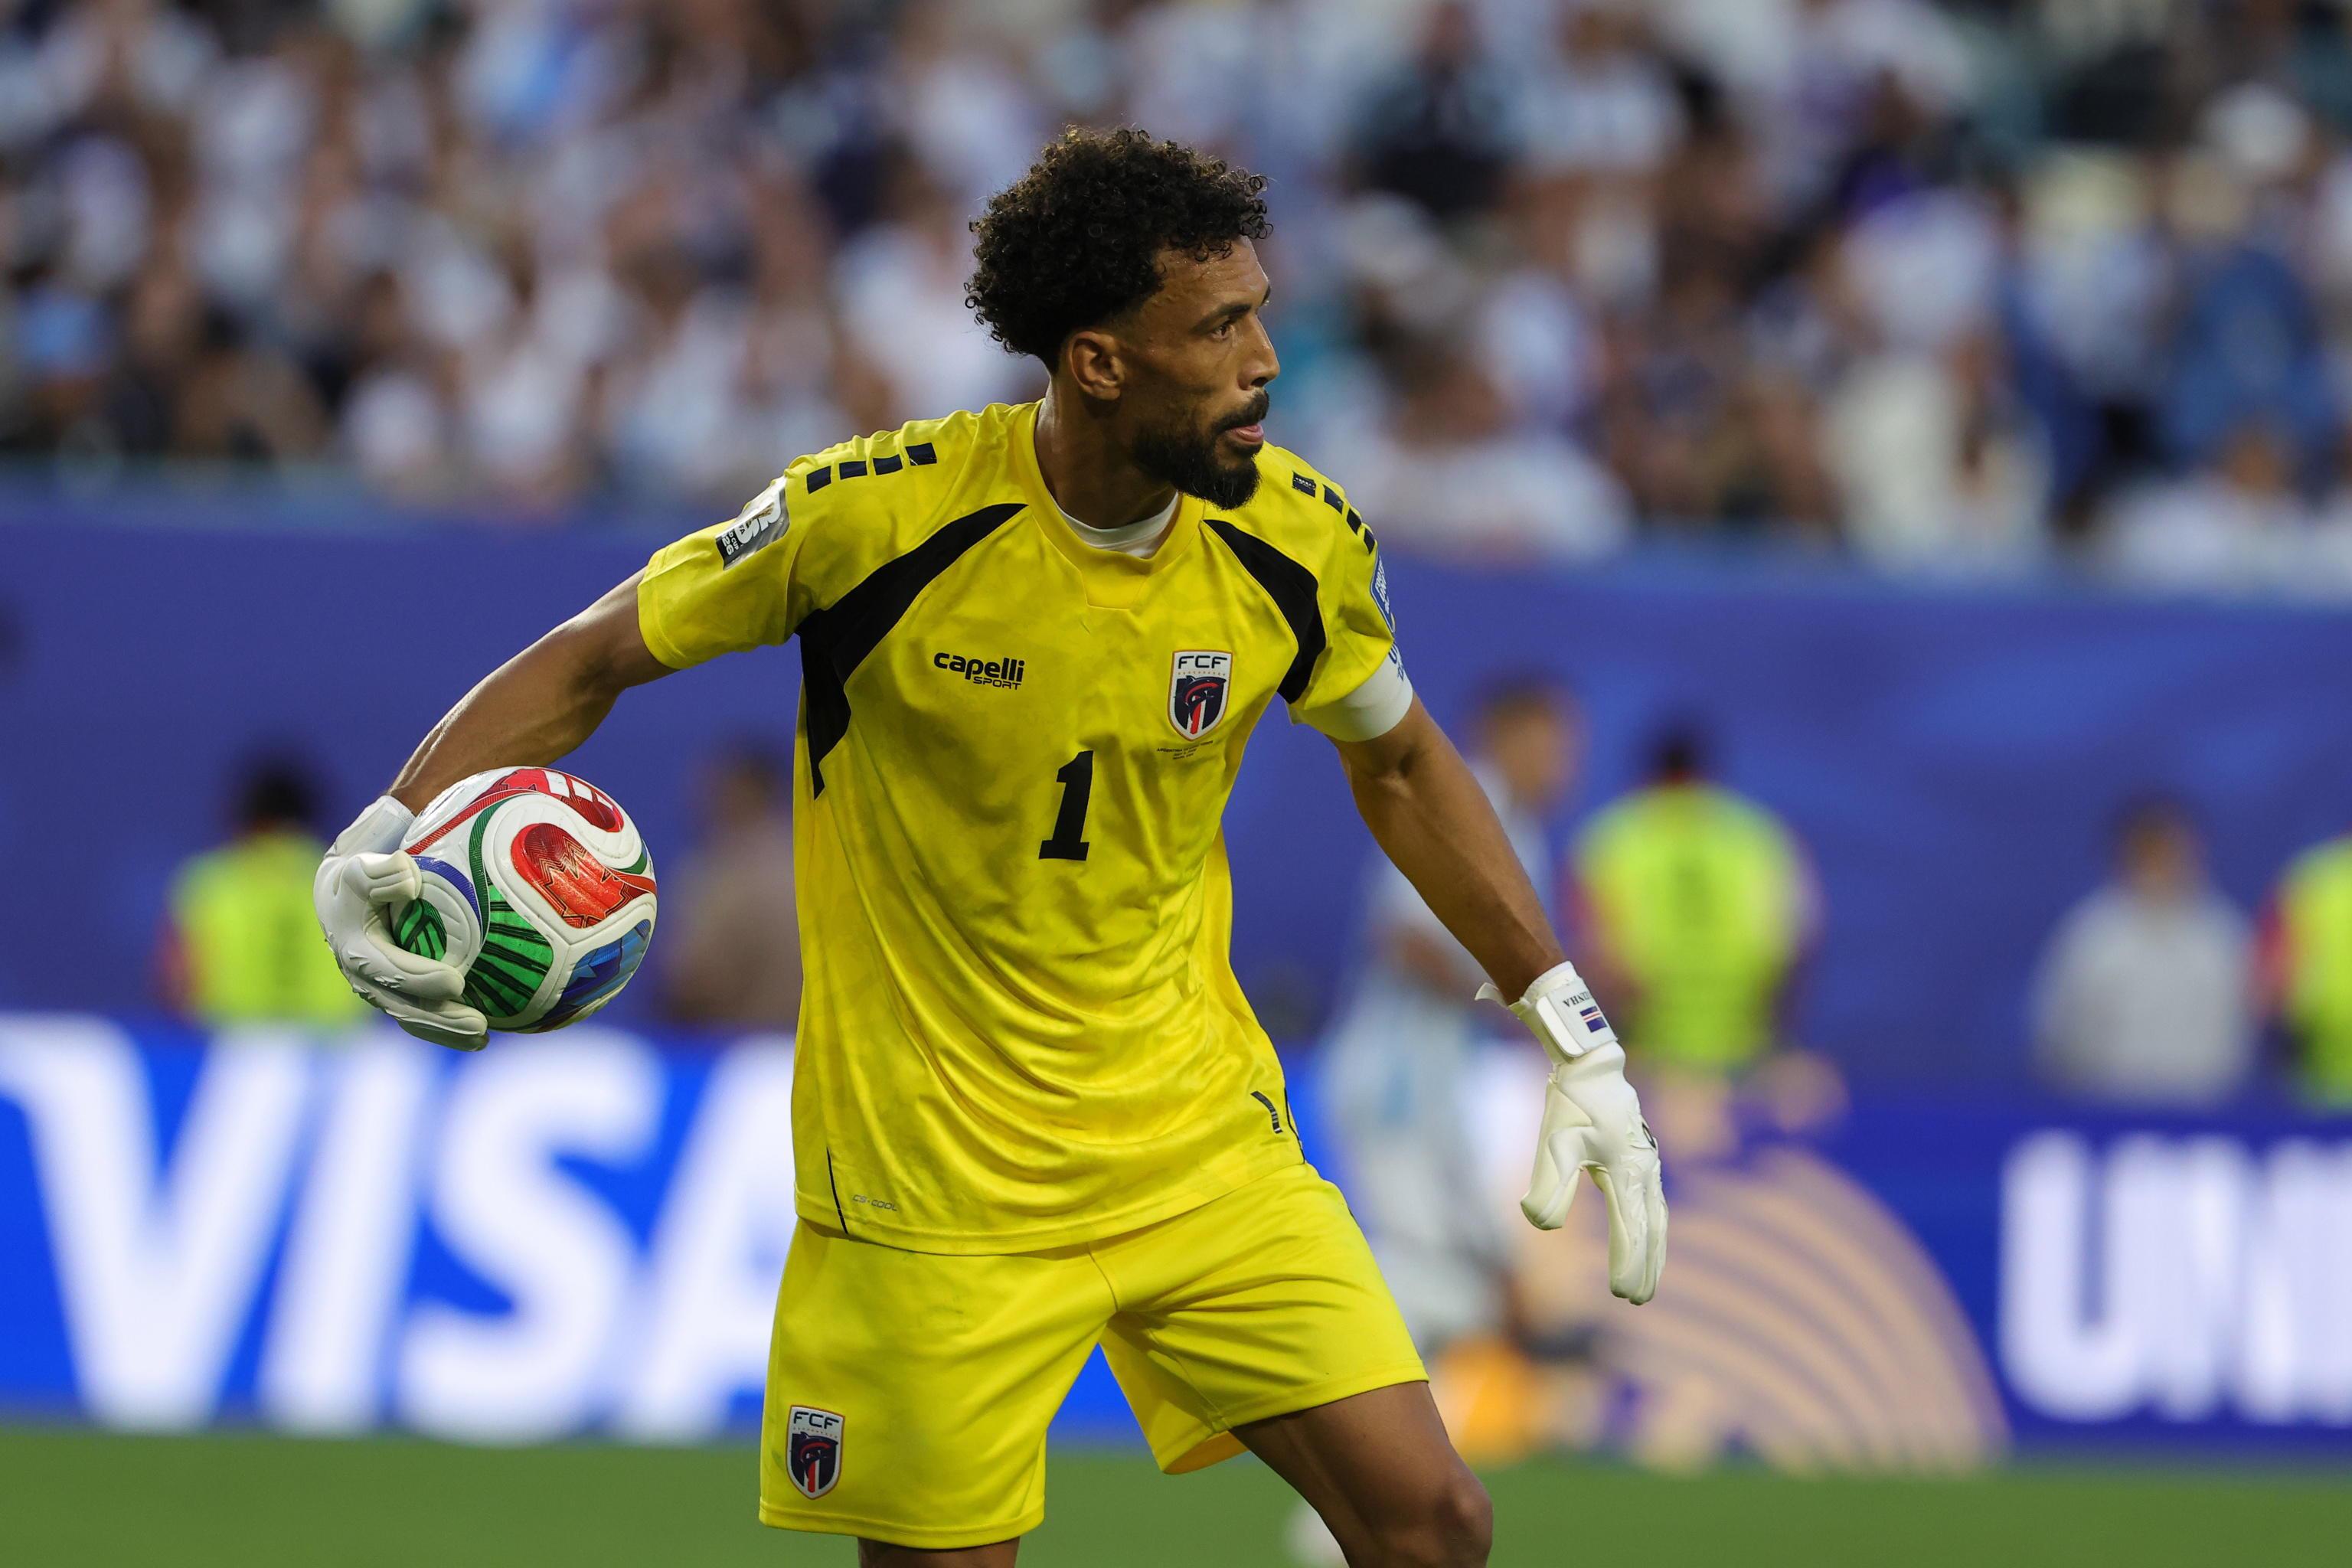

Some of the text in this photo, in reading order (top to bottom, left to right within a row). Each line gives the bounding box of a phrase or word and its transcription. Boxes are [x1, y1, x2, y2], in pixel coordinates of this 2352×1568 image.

[730, 537, 740, 550] CUP
[933, 652, 1024, 682] capelli
[1178, 655, 1227, 669] FCF
[973, 676, 1021, 690] SPORT
[1038, 750, 1094, 861] 1
[793, 1411, 839, 1429] FCF
